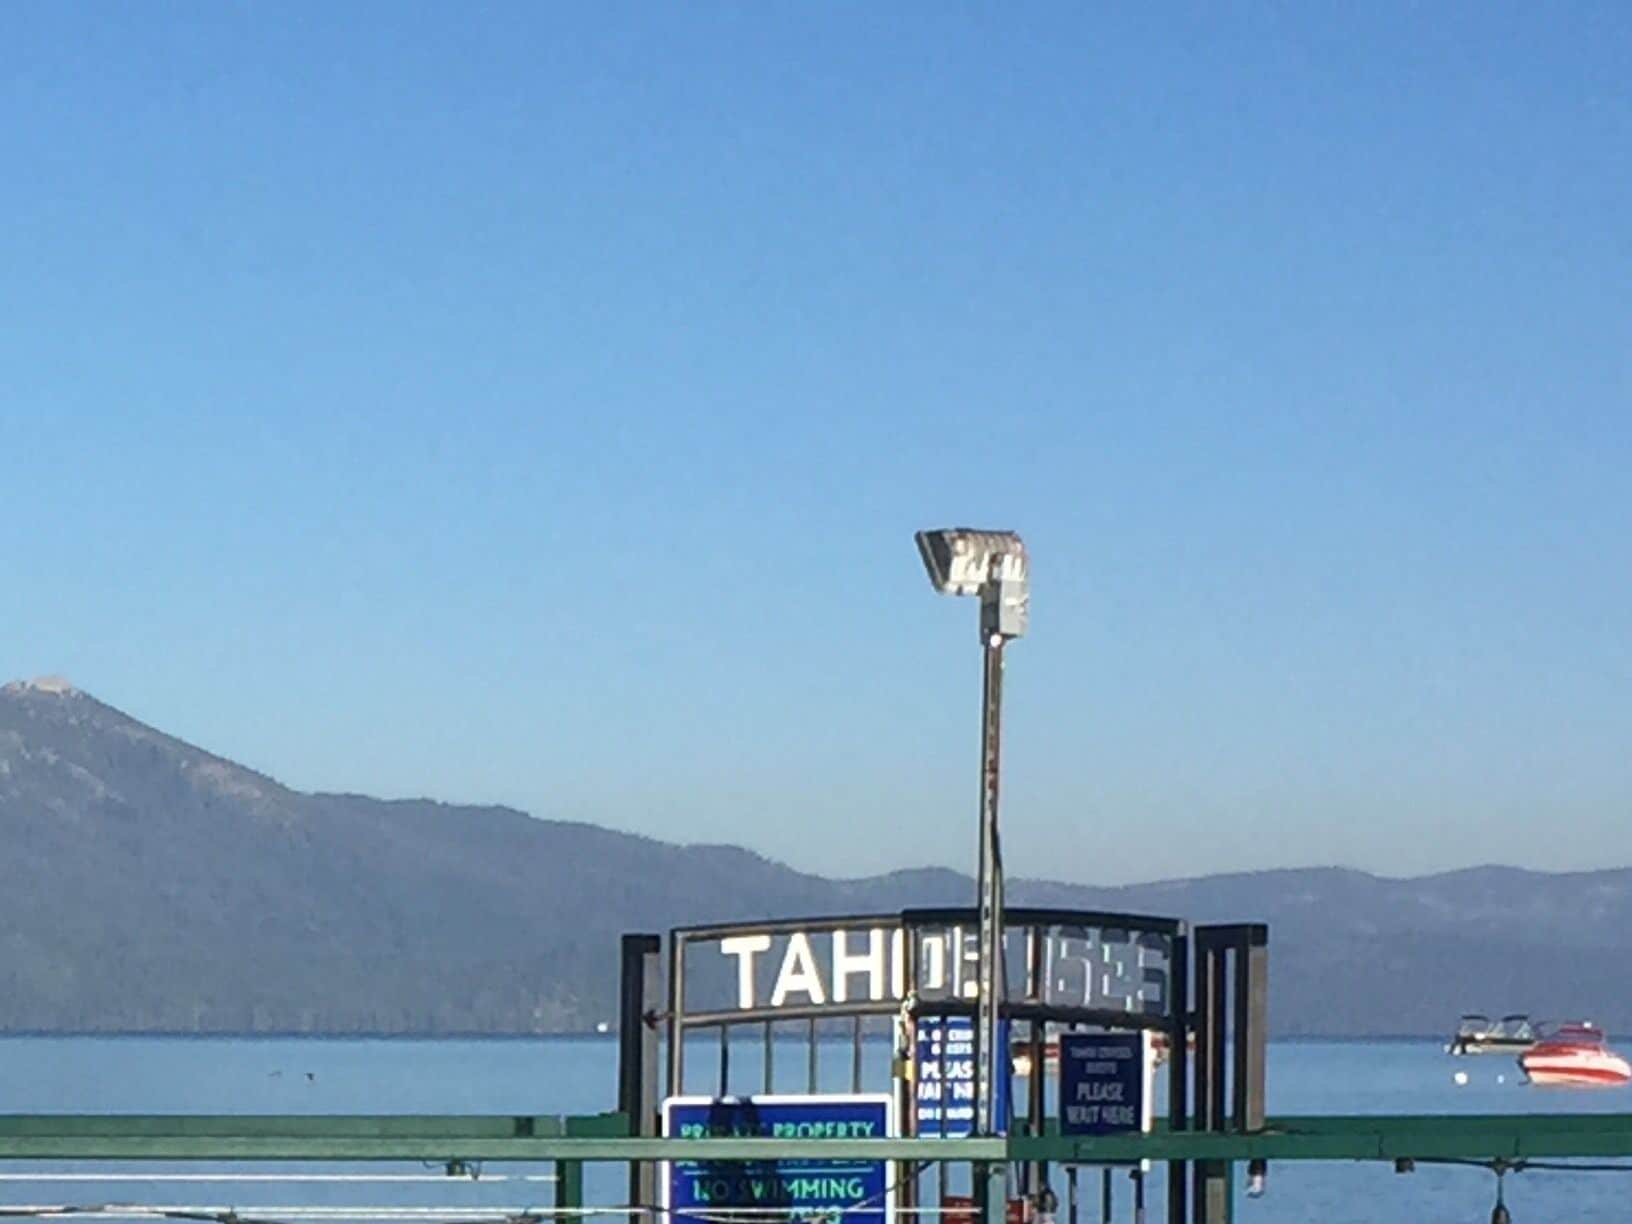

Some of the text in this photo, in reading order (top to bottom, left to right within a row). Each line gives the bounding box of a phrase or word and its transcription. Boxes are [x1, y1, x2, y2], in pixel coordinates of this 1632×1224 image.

[1076, 1082, 1124, 1101] PLEASE
[1066, 1104, 1099, 1125] WAIT
[773, 1121, 876, 1139] PROPERTY
[738, 1177, 865, 1199] SWIMMING
